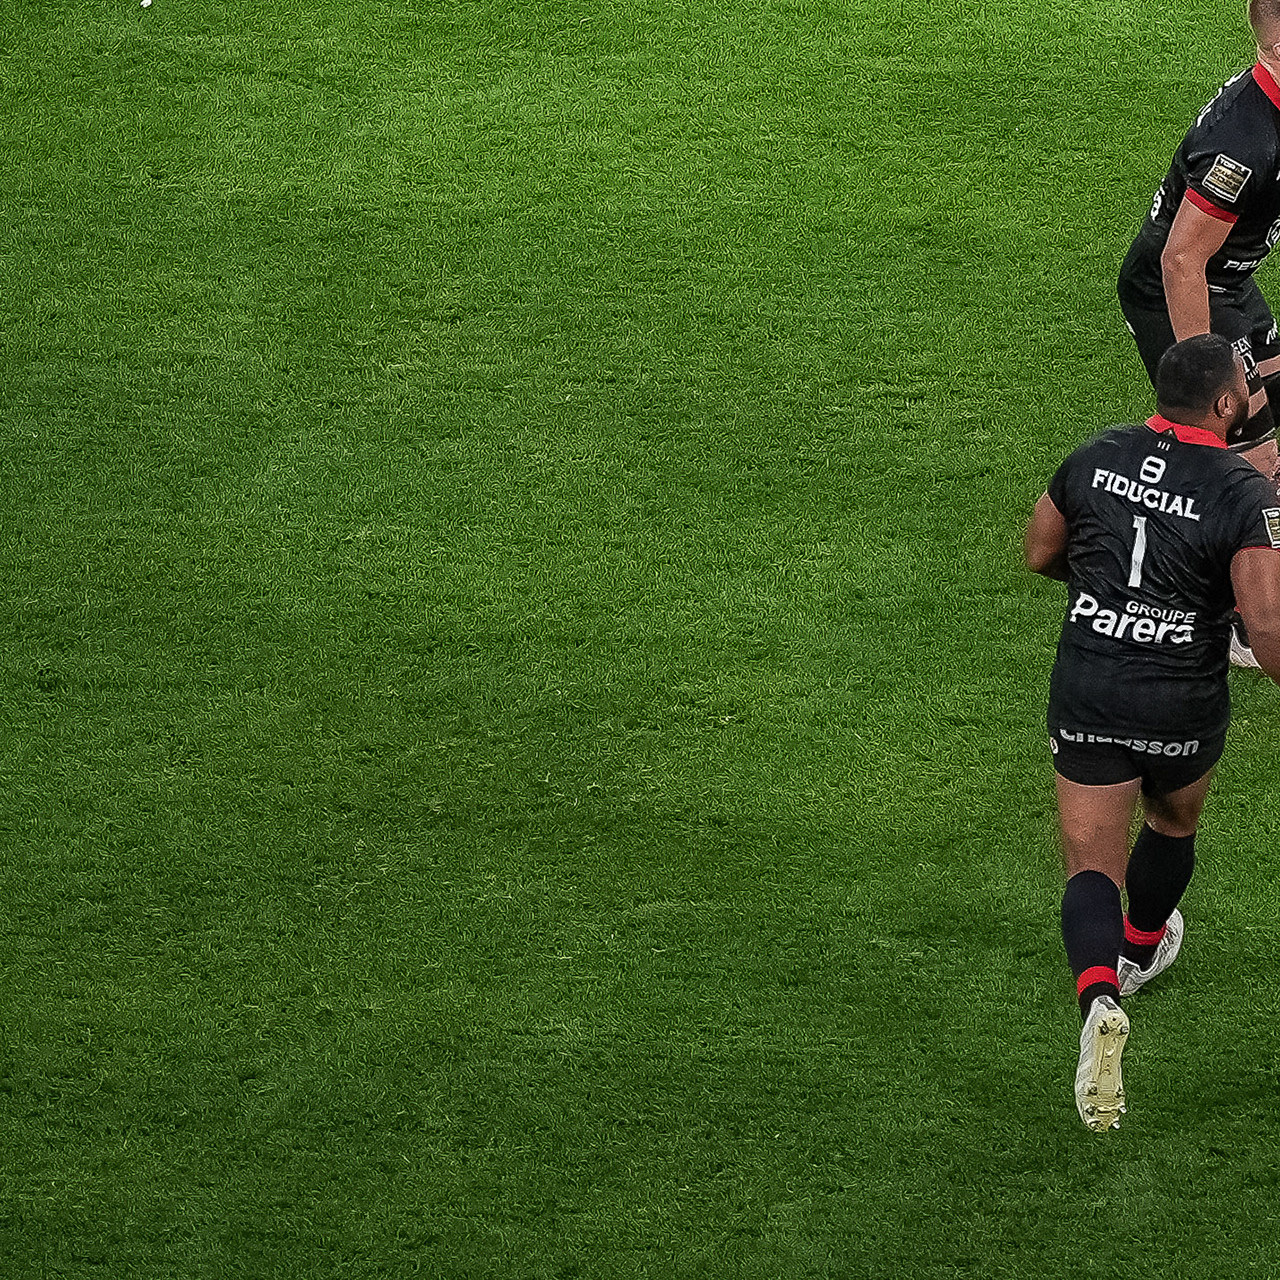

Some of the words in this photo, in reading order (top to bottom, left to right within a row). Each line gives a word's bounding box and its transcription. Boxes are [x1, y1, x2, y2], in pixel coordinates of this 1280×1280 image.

[1091, 468, 1201, 521] FIDUCIAL
[1127, 514, 1148, 588] 1
[1069, 591, 1196, 644] Parera
[1125, 599, 1198, 625] GROUPE
